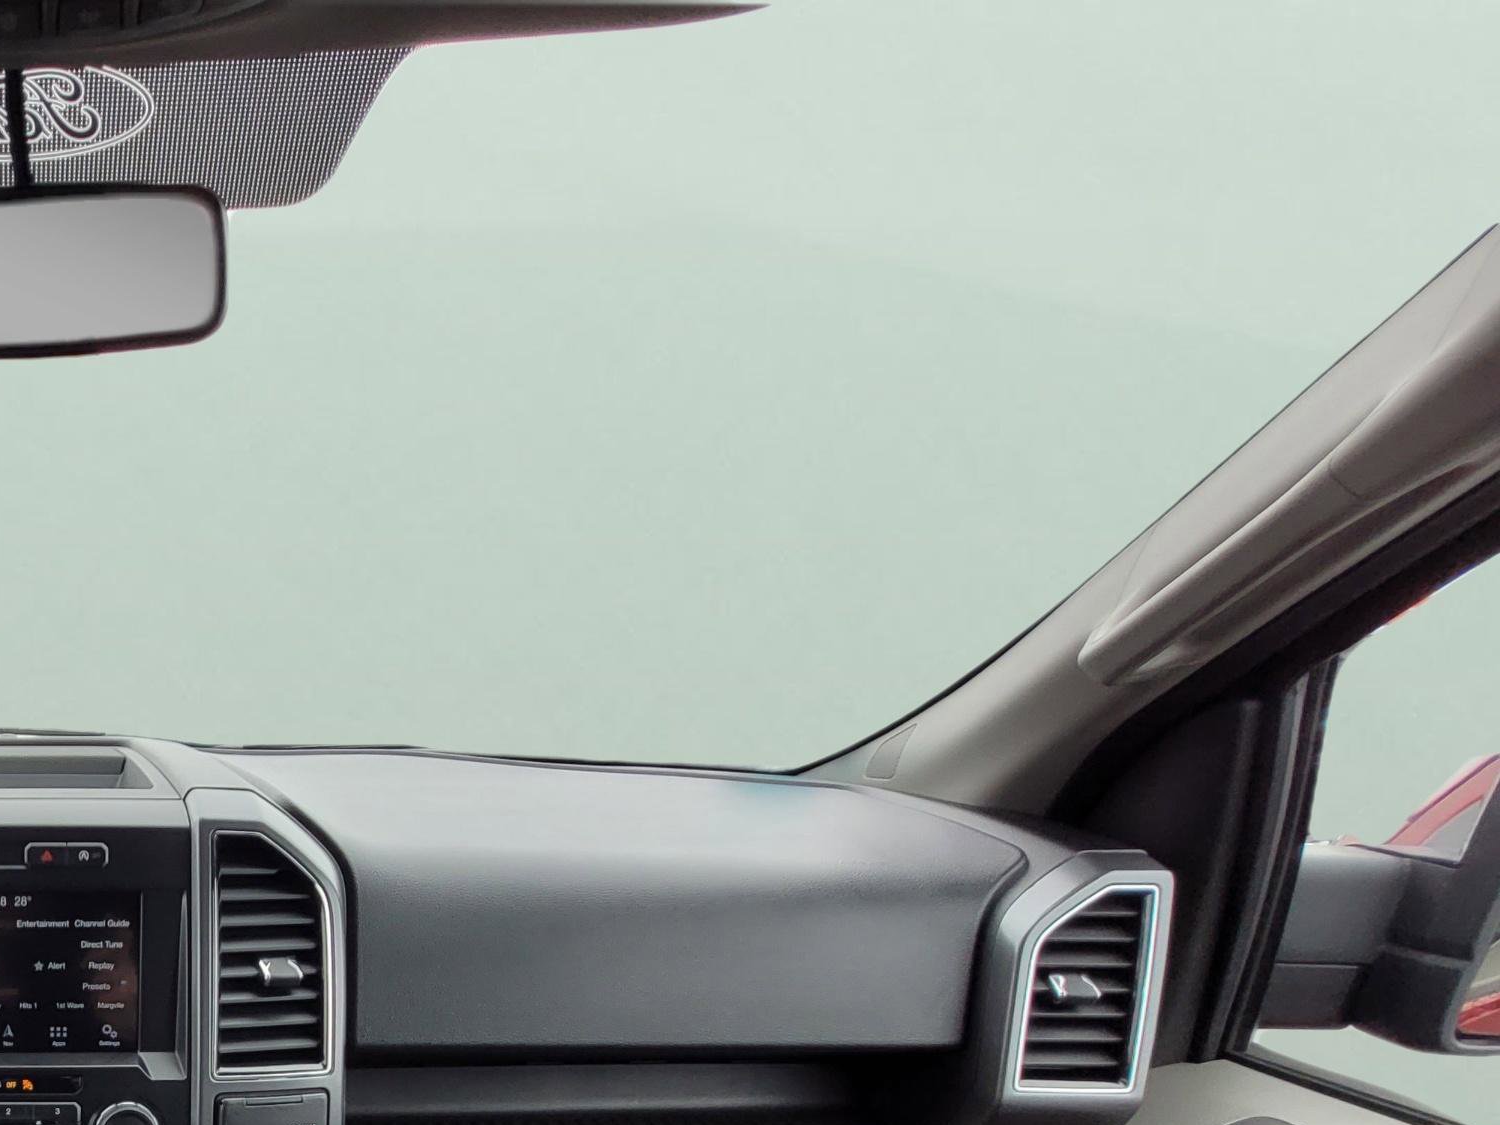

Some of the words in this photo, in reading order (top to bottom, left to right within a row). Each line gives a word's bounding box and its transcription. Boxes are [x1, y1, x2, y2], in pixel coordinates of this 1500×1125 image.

[16, 920, 69, 928] Entertainment
[81, 941, 102, 949] Direct
[105, 941, 123, 949] Tune
[48, 962, 65, 970] Alert
[89, 962, 114, 971] Replay
